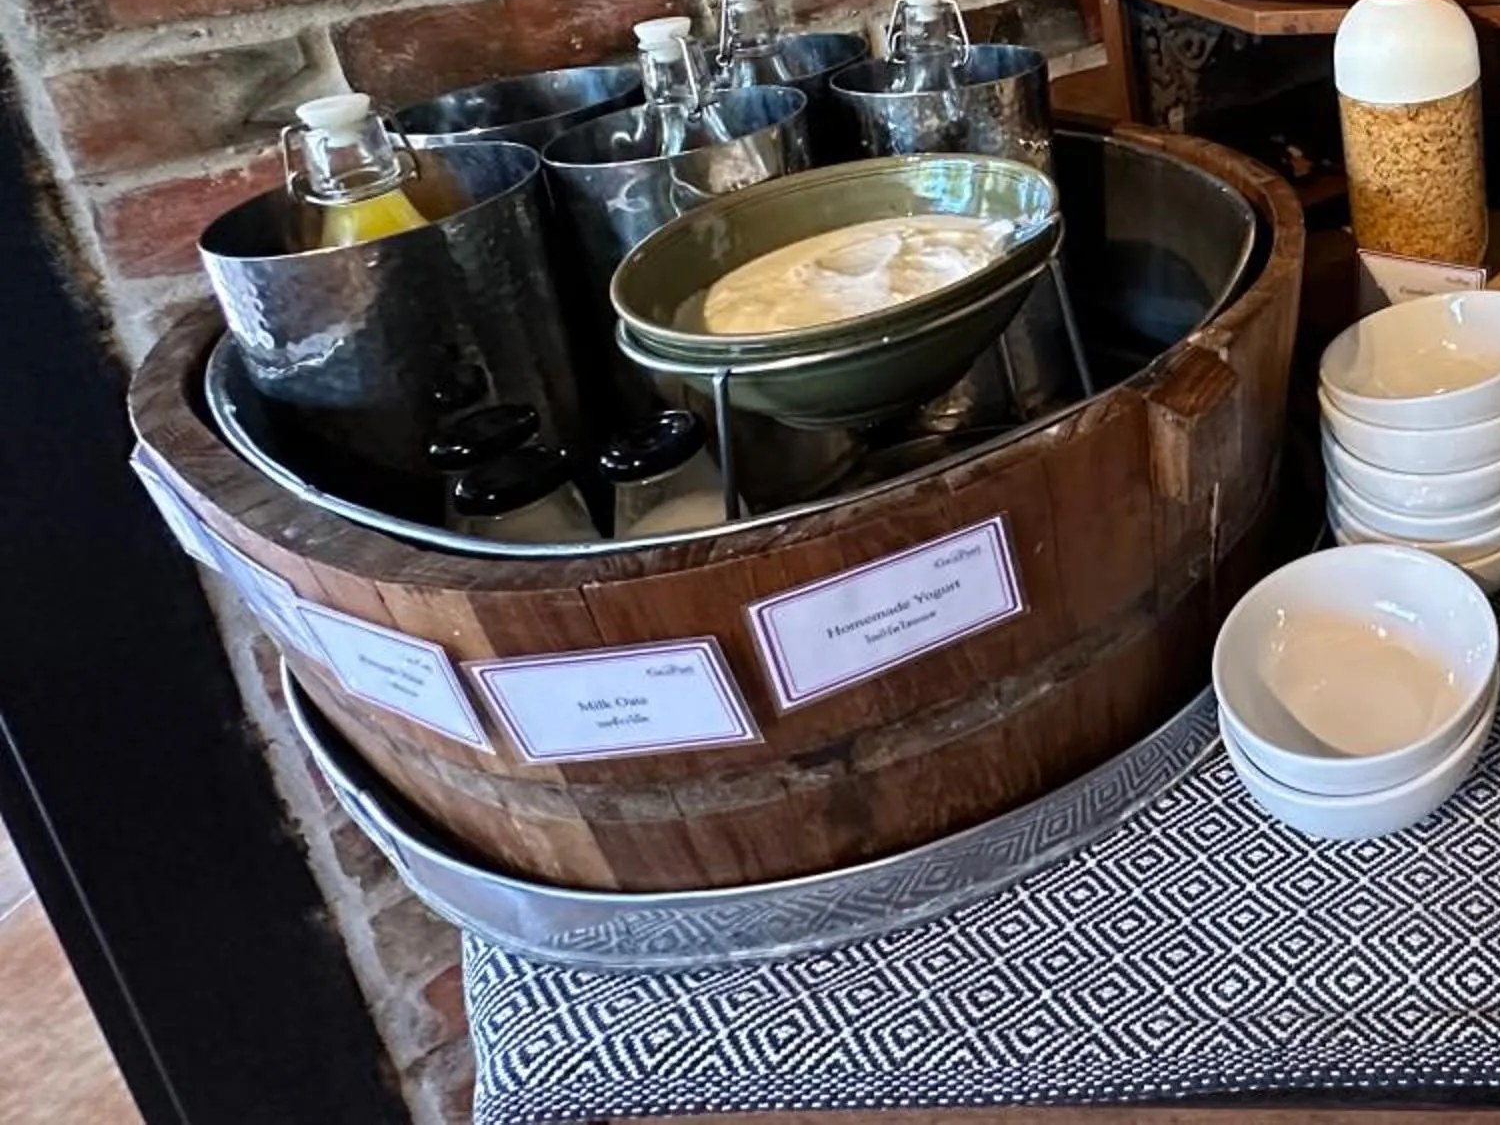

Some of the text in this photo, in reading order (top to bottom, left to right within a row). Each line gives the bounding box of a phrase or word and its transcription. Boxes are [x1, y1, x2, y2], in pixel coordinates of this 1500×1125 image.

[826, 600, 911, 639] Homemade
[912, 579, 962, 604] Yogurt
[576, 697, 612, 712] Milk
